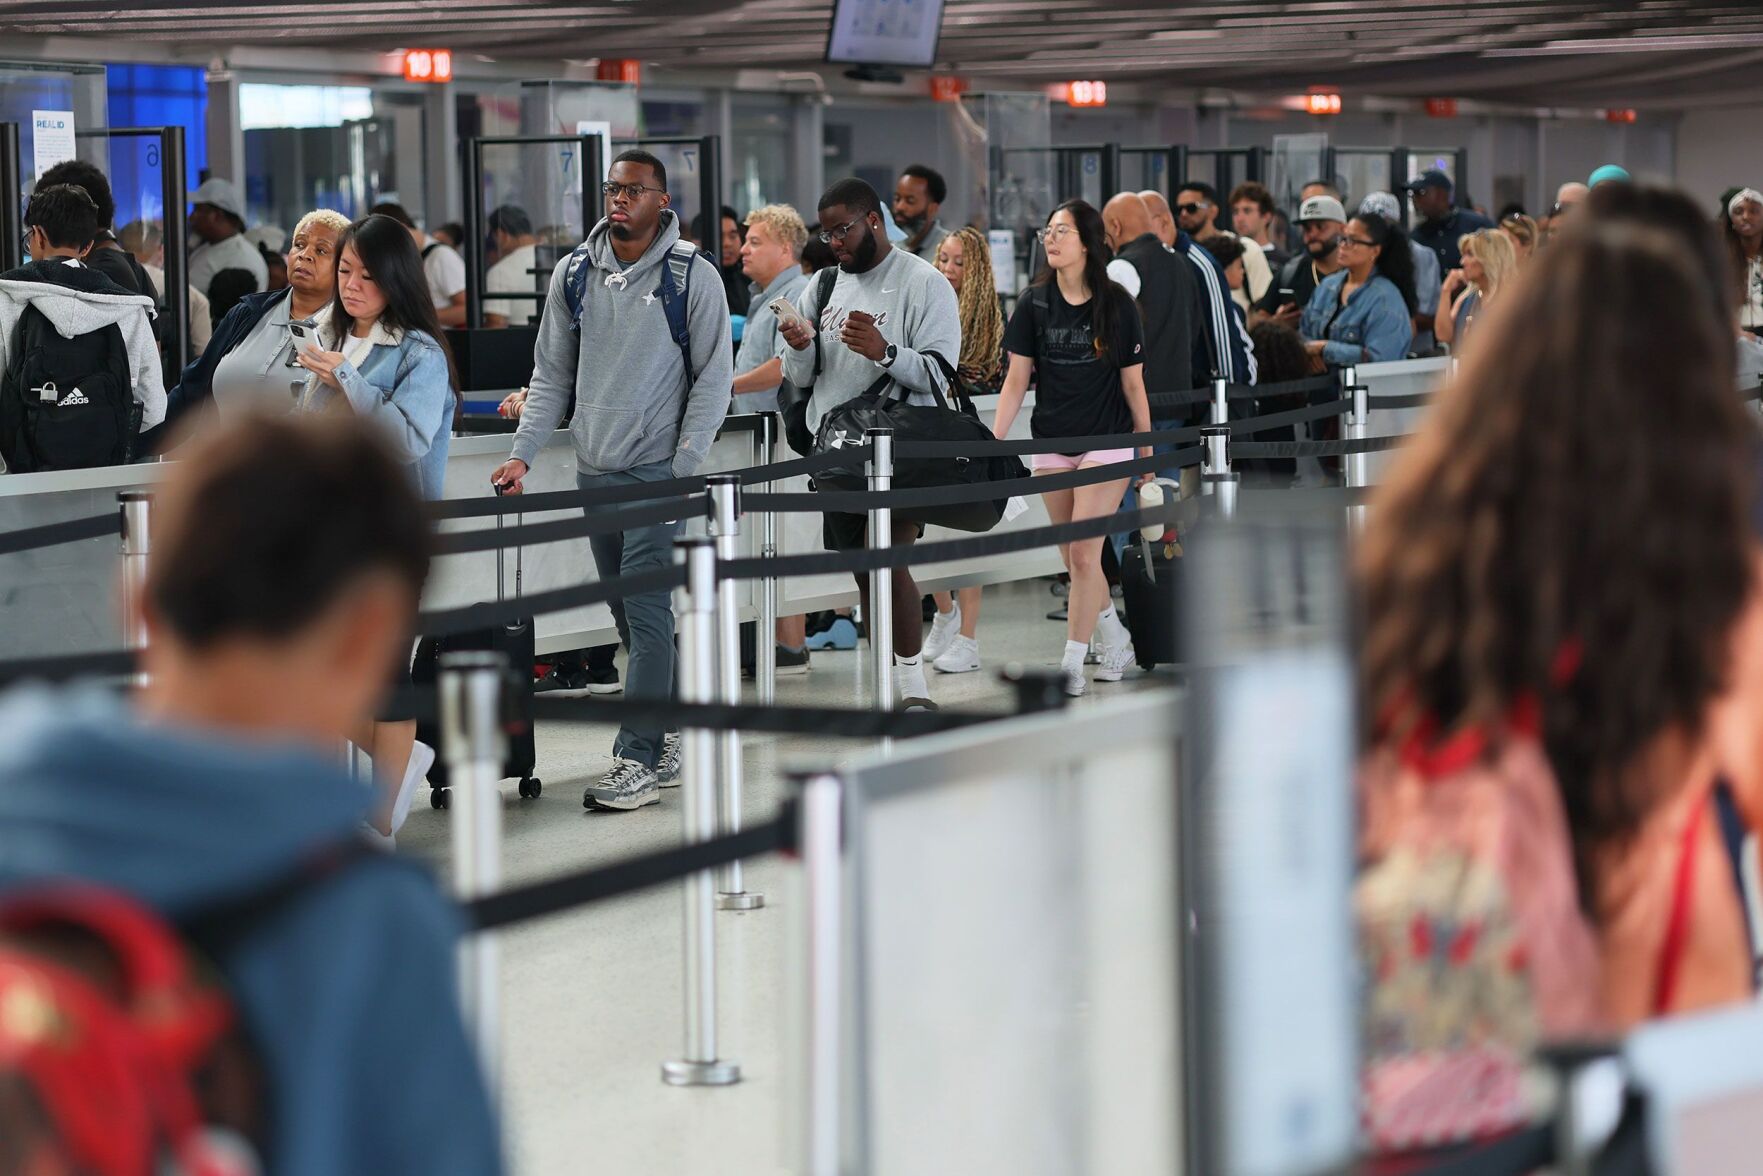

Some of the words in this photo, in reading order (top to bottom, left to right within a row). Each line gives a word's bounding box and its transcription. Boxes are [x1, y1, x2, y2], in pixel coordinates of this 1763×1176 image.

[36, 120, 56, 129] REAL
[57, 121, 65, 129] ID
[561, 151, 573, 172] 7
